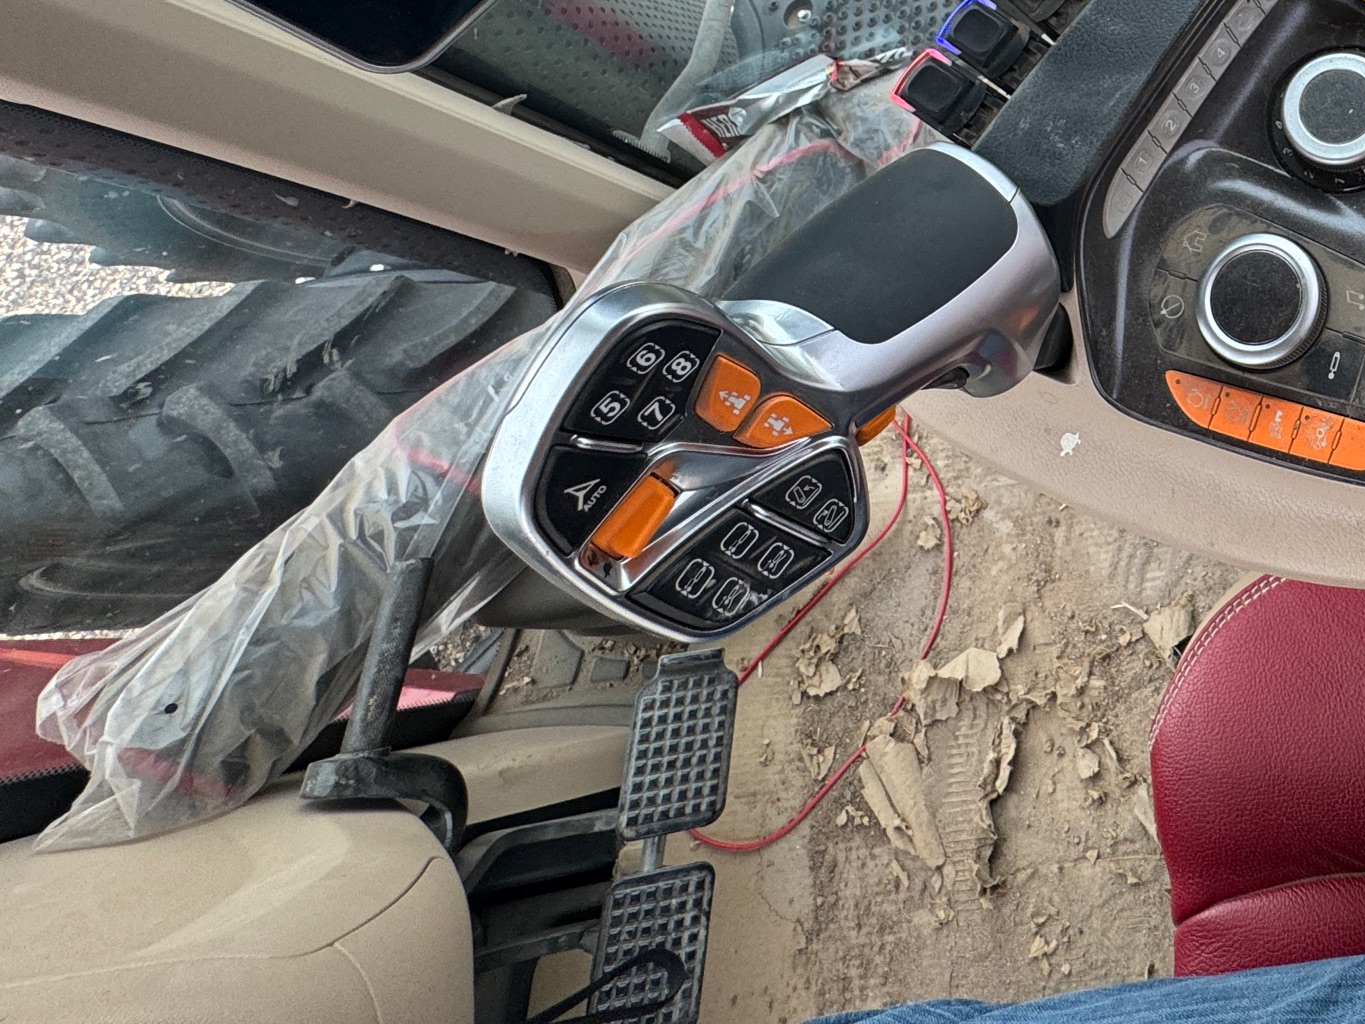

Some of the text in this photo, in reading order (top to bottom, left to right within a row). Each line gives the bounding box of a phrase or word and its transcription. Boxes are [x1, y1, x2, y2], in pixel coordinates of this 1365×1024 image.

[636, 349, 656, 366] 6
[671, 357, 692, 376] 8
[599, 397, 621, 417] 5
[644, 401, 664, 422] 7
[583, 485, 607, 512] AUTO
